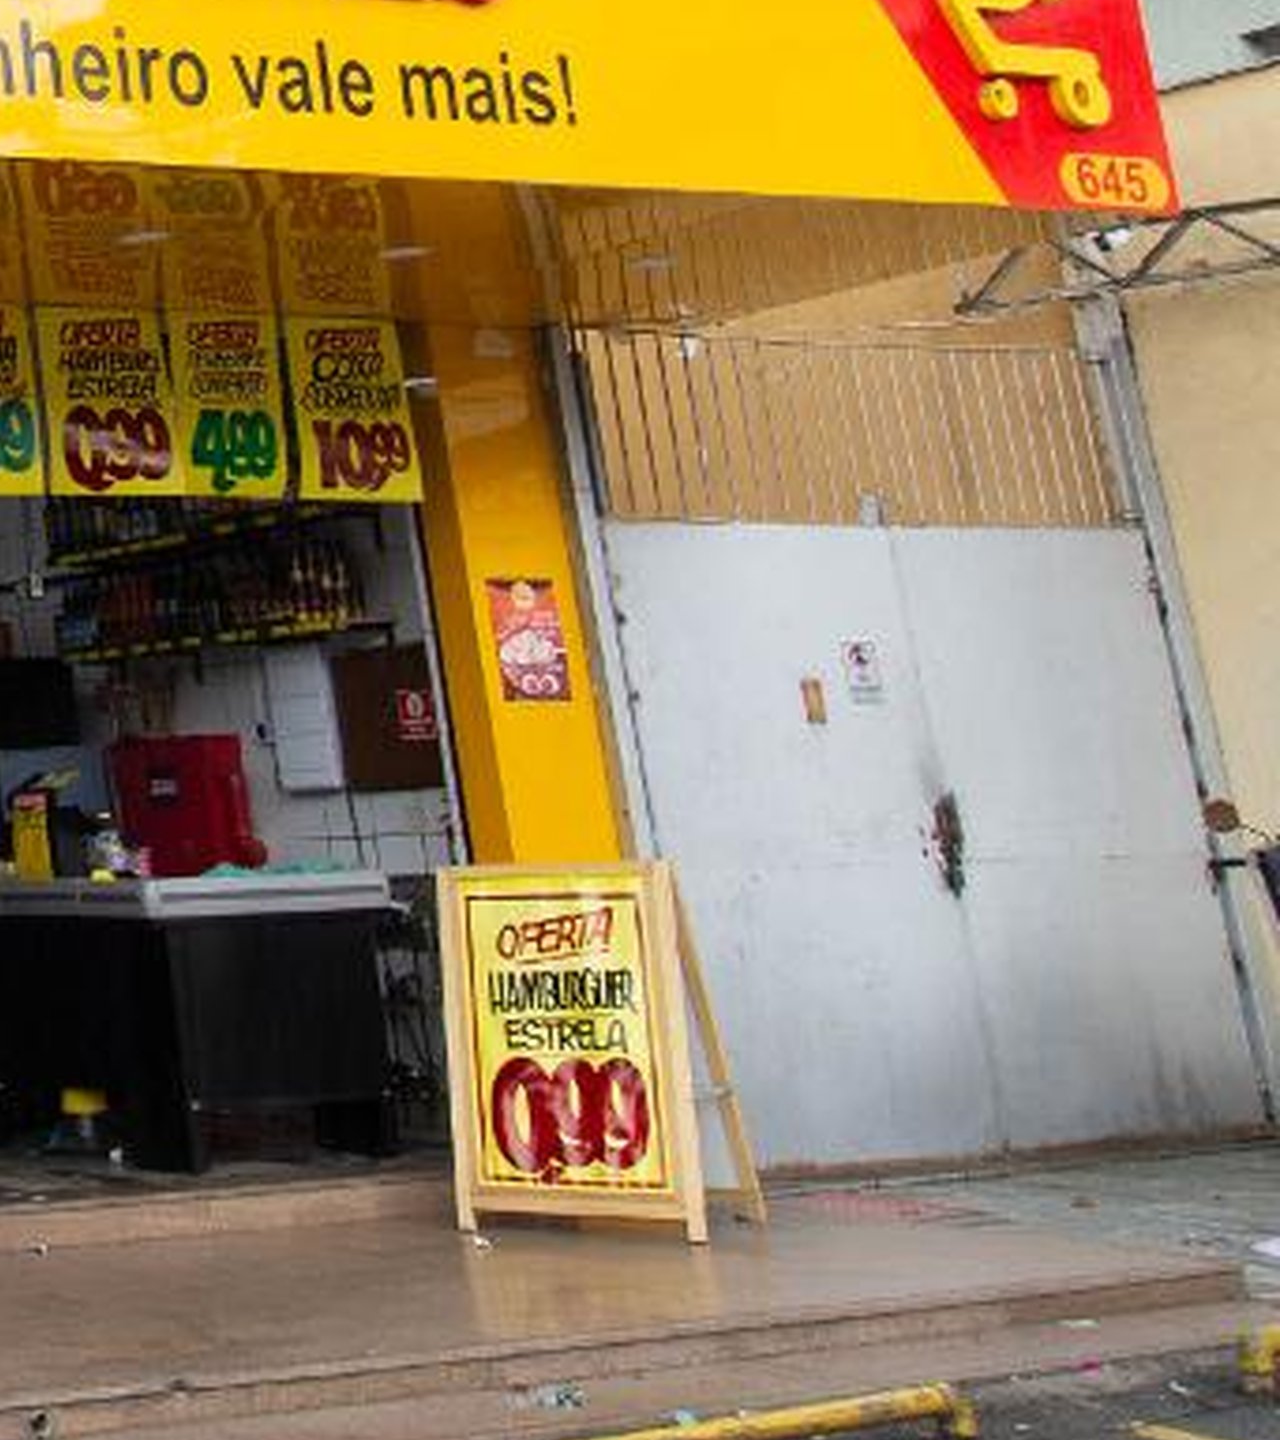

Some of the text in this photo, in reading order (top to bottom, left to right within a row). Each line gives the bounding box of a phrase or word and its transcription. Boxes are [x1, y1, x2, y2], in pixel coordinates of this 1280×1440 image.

[233, 37, 377, 119] vale
[400, 54, 580, 127] mais!
[1076, 158, 1149, 204] 645
[503, 1019, 629, 1053] ESTRELA
